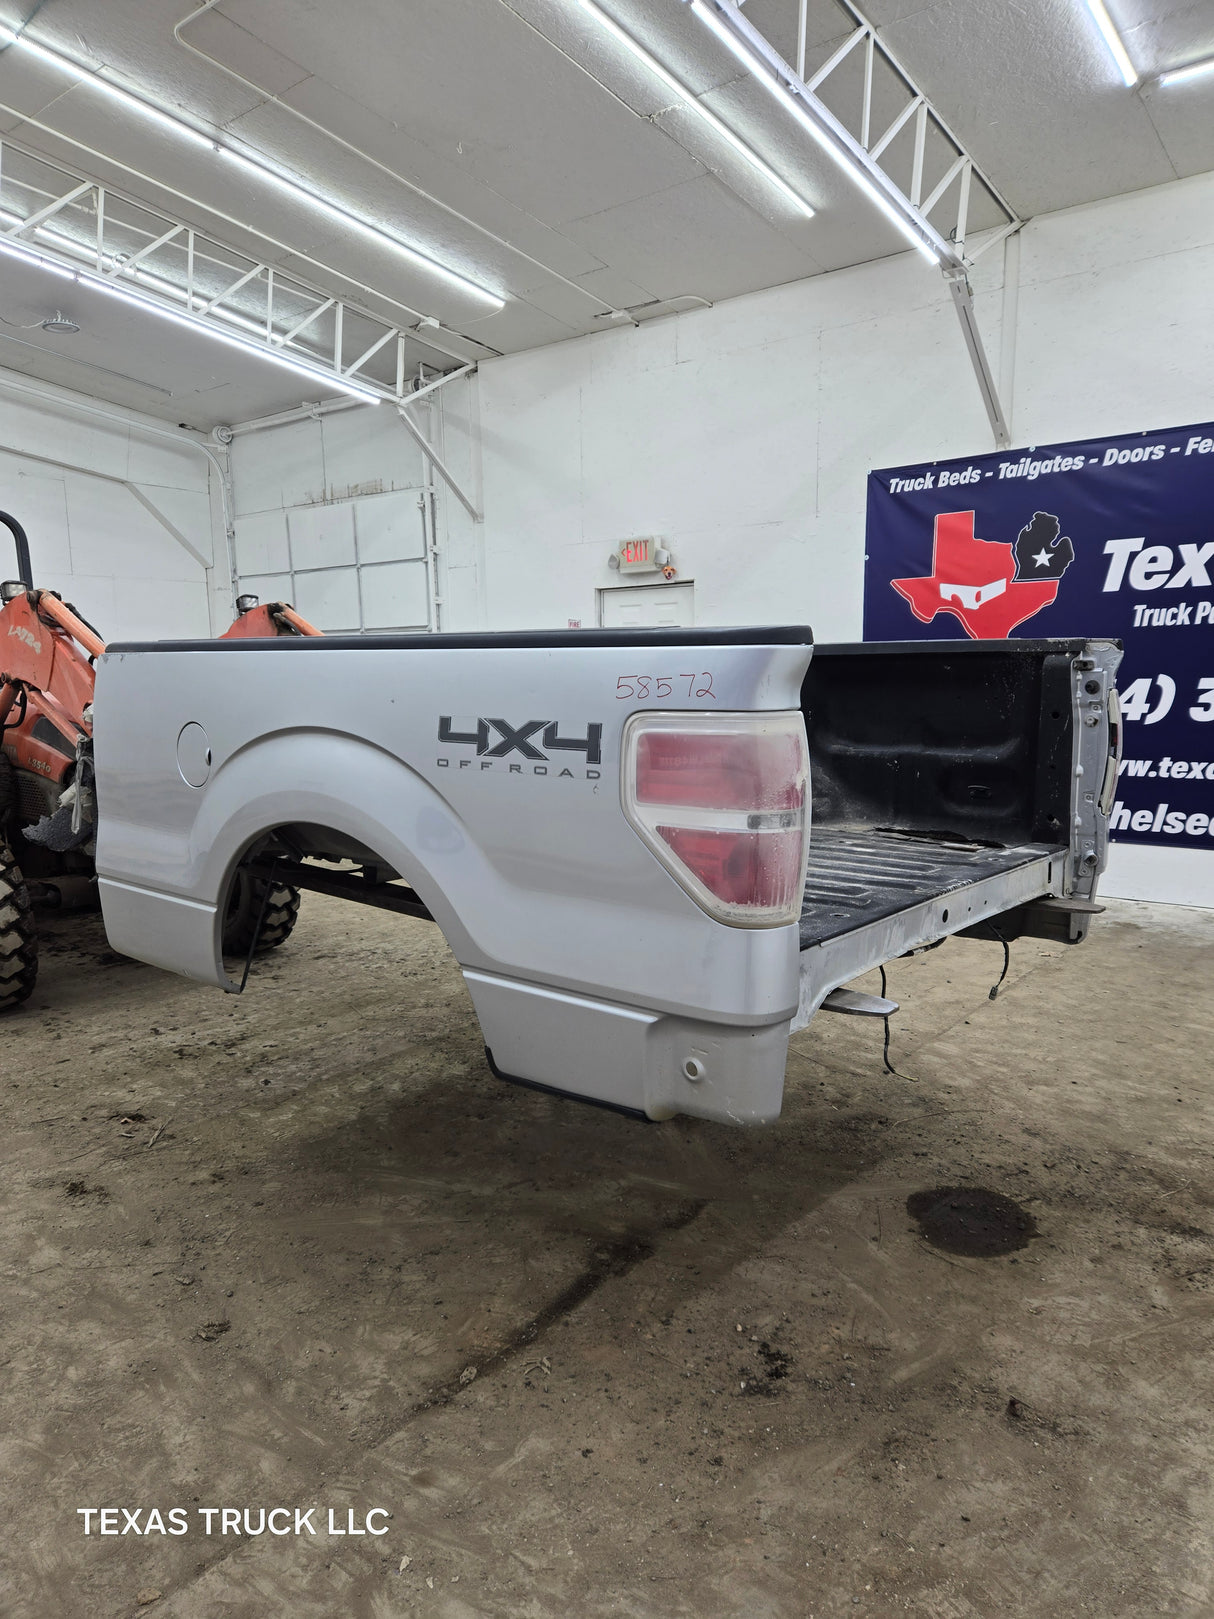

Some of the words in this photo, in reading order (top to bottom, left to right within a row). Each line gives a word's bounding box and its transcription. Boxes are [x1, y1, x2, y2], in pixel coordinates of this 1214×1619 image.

[889, 472, 936, 494] Truck
[937, 466, 982, 488] Beds
[998, 455, 1085, 481] Tailgates
[1102, 444, 1166, 467] Doors
[1184, 436, 1214, 456] Fe
[626, 539, 649, 563] EXIT
[1102, 536, 1214, 593] Tex
[1133, 602, 1194, 627] Truck
[615, 672, 716, 699] 58572
[1115, 673, 1177, 725] 4)
[1109, 800, 1214, 836] helse
